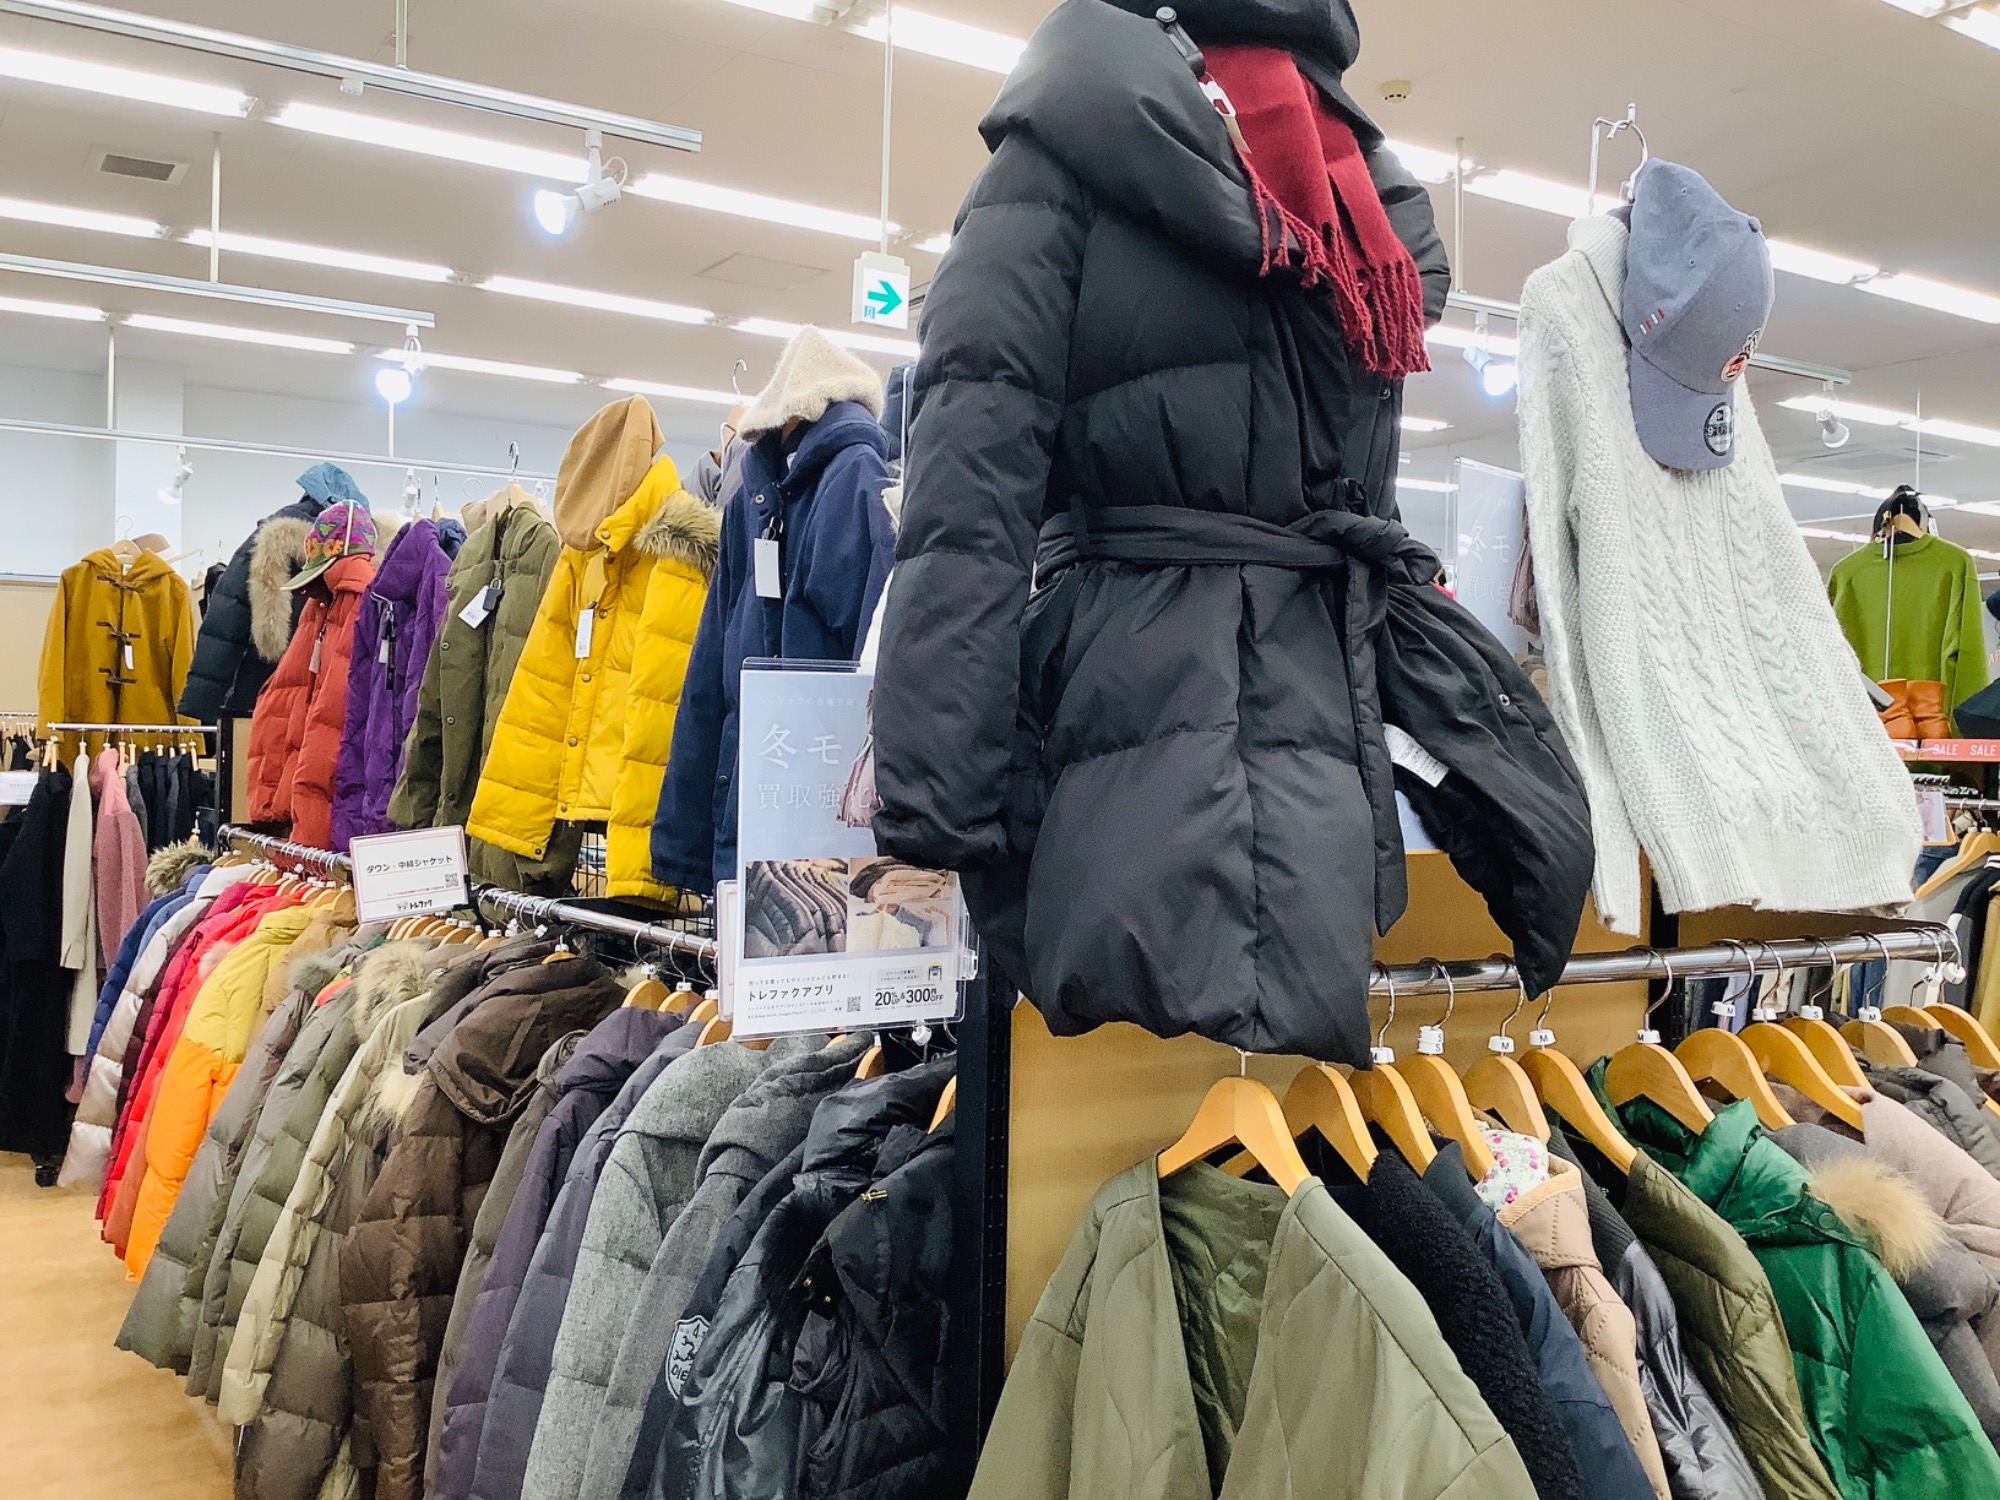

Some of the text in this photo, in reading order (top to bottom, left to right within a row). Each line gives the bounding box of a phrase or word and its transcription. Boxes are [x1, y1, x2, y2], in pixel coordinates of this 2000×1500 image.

[1932, 743, 1997, 757] SALE SALE
[749, 984, 833, 1002] トレファクアプリ
[1540, 1034, 1548, 1042] M
[1501, 1042, 1510, 1050] M
